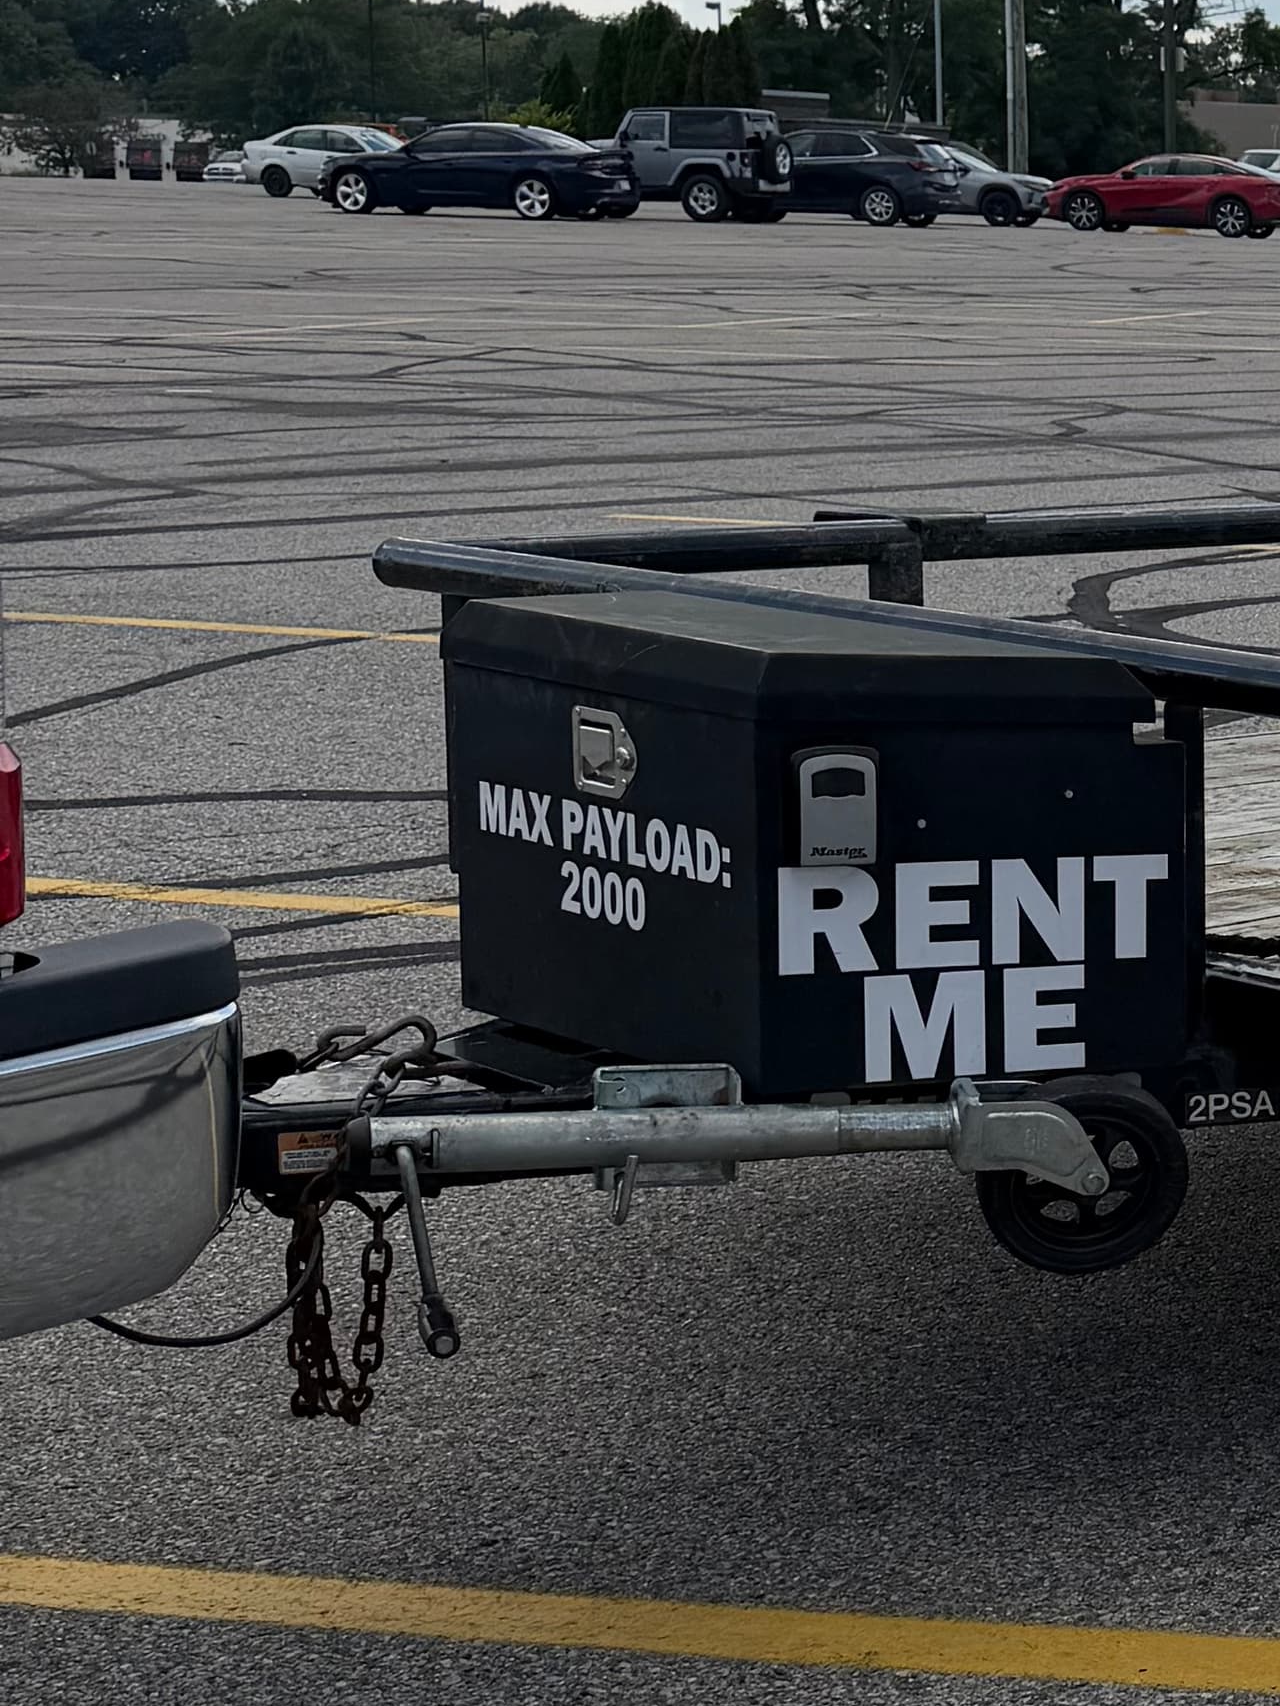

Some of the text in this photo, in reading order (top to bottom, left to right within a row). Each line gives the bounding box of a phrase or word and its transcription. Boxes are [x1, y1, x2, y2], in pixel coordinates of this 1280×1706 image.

[479, 780, 732, 888] MAX PAYLOAD:
[809, 846, 868, 860] Master
[560, 860, 646, 931] 2000
[777, 853, 1169, 976] RENT
[863, 963, 1087, 1084] ME
[1188, 1089, 1276, 1122] 2PSA
